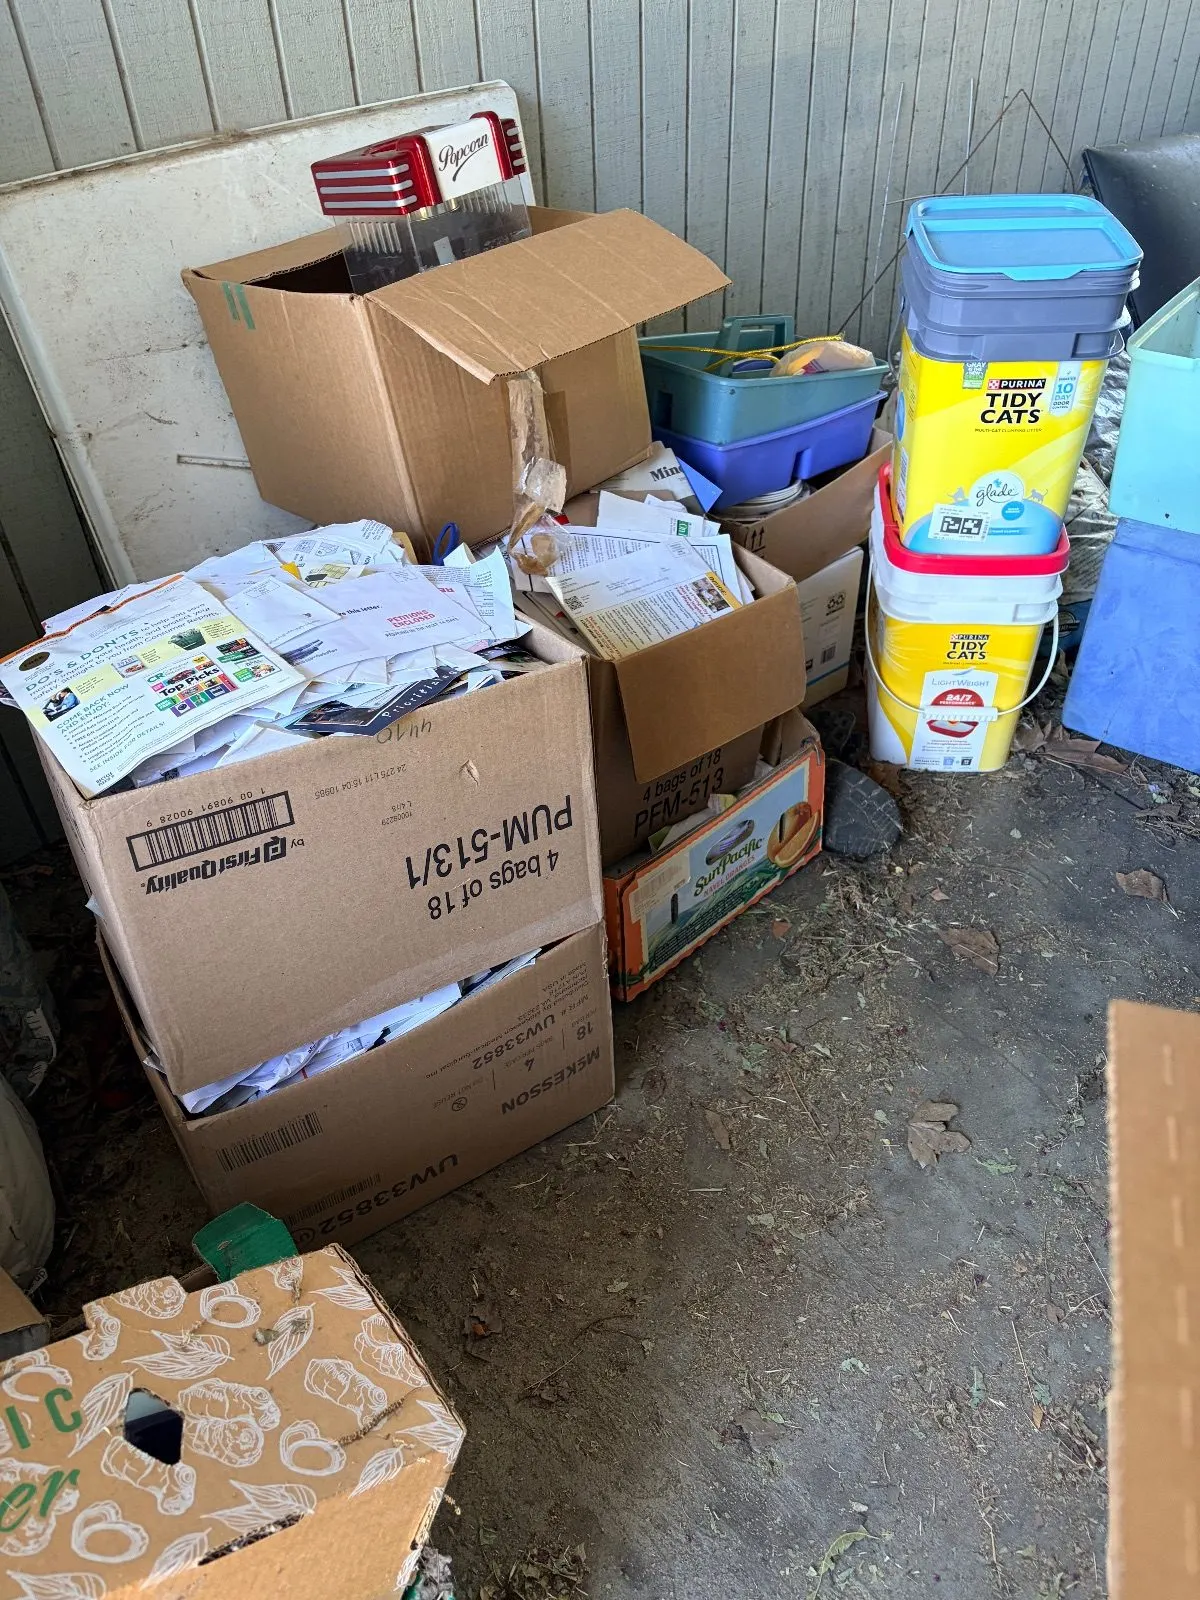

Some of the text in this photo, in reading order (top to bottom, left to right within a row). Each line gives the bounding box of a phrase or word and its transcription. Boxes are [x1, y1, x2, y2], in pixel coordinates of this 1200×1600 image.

[439, 133, 489, 172] Popcorn
[1001, 380, 1043, 388] PURINA
[1056, 383, 1074, 394] 10
[986, 392, 1043, 408] TIDY
[980, 409, 1041, 424] CATS
[976, 483, 1019, 507] glade
[387, 609, 429, 622] PETITIONS
[392, 613, 436, 628] ENCLOSED
[950, 642, 987, 650] TIDY
[26, 668, 63, 692] DO'S
[67, 661, 77, 669] &
[80, 629, 139, 660] DON'TS
[947, 651, 986, 659] CATS
[147, 672, 165, 683] CR
[159, 683, 184, 697] Top
[185, 667, 220, 685] Picks
[946, 694, 972, 702] 24/7
[56, 711, 83, 730] COME
[83, 696, 107, 713] BACK
[106, 684, 129, 698] NOW
[61, 720, 80, 734] AND
[80, 702, 111, 721] ENJOY:
[643, 748, 721, 802] 4 bags of 18
[240, 791, 253, 801] 00
[634, 767, 724, 839] PFM-513
[201, 797, 234, 812] 90891
[146, 819, 153, 828] 9
[159, 808, 194, 824] 90028
[290, 838, 305, 849] by
[405, 794, 573, 890] PUM-513/1
[703, 855, 756, 897] NAVEL ORANGES
[427, 849, 559, 920] 4 bags of 18
[576, 1021, 594, 1041] 18
[472, 1014, 556, 1070] UW33852
[524, 1058, 535, 1072] 4
[318, 1153, 458, 1235] UW33852
